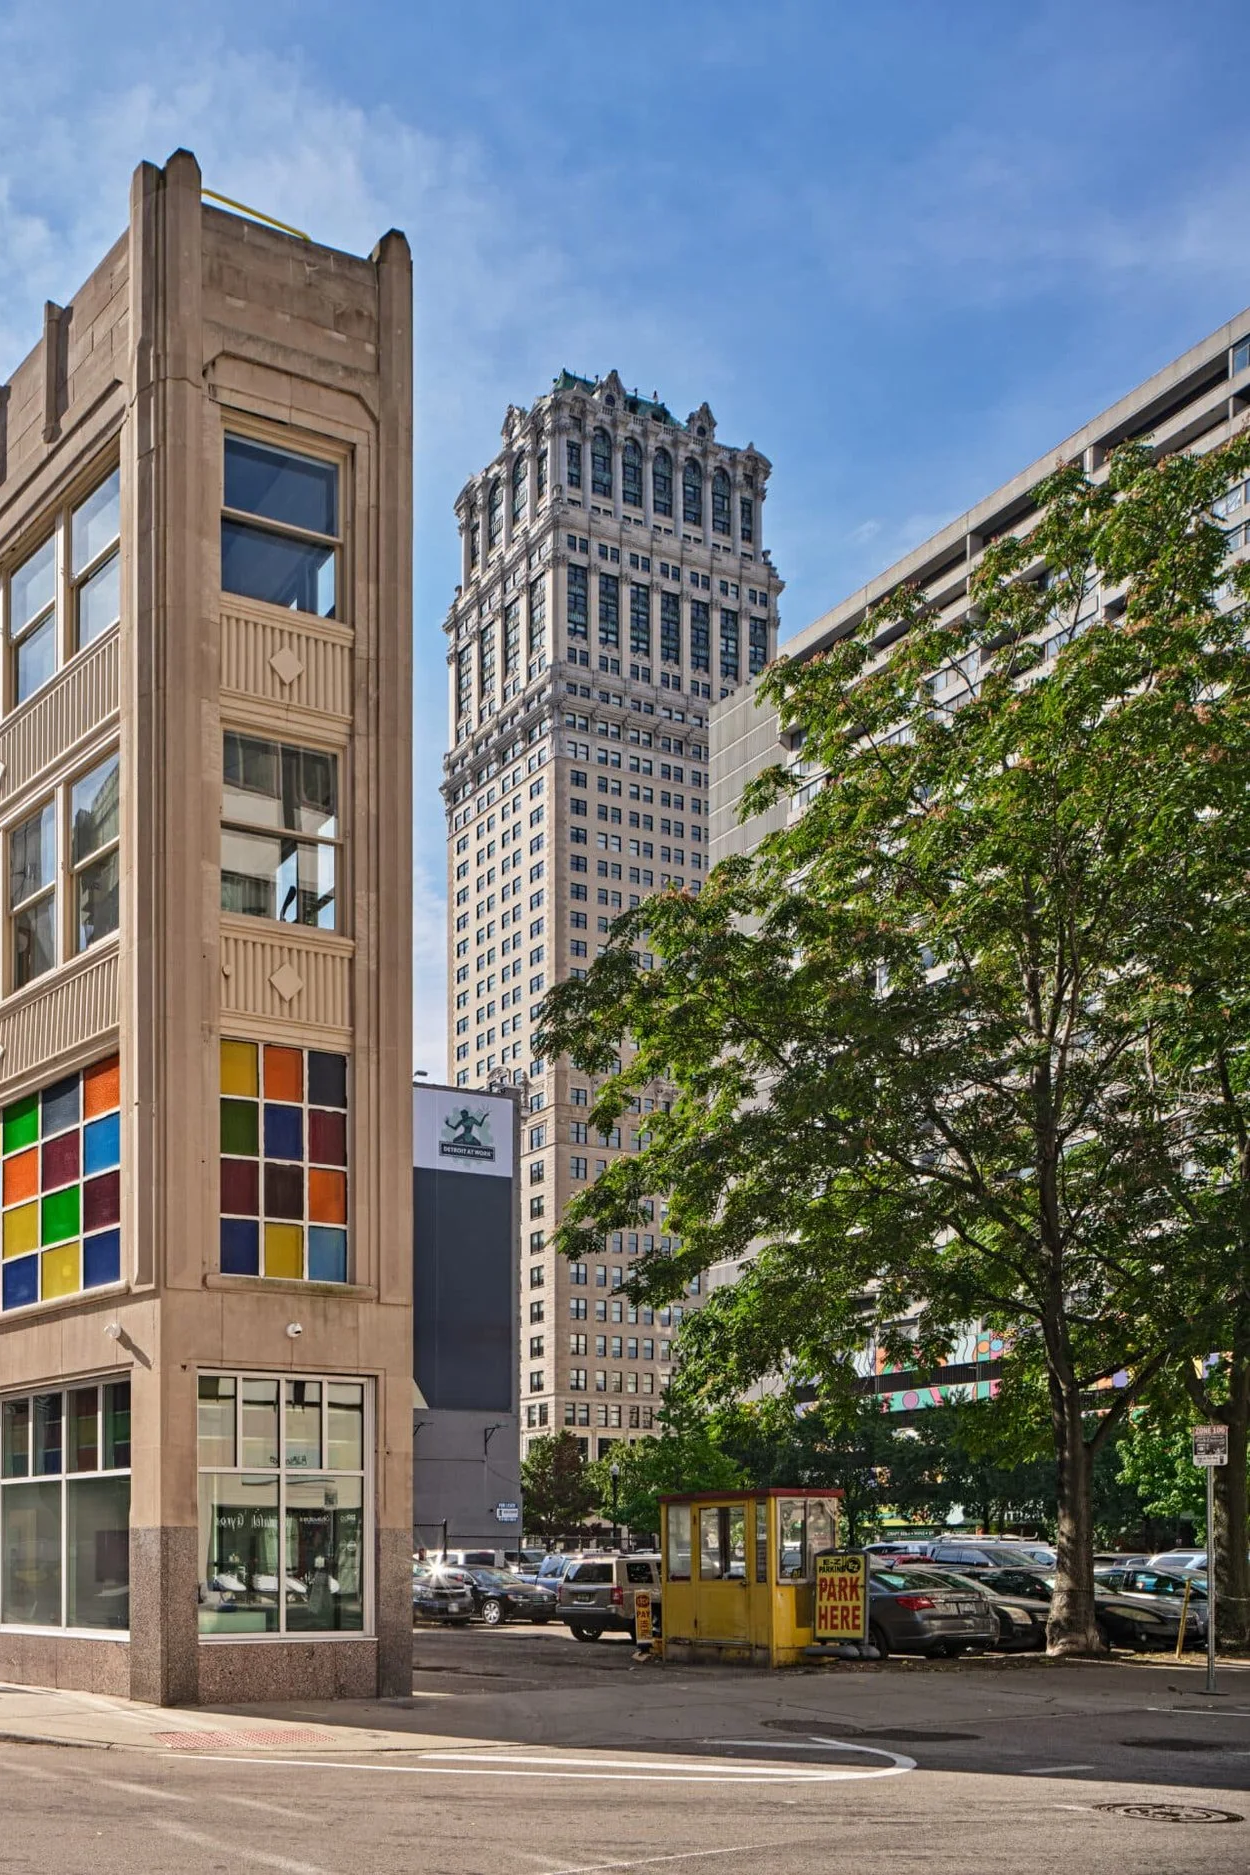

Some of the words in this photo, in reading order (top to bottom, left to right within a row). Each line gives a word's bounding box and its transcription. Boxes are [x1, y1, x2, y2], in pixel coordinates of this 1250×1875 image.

[443, 1145, 467, 1155] DETROIT
[1195, 1425, 1211, 1435] ZONE
[819, 1577, 860, 1602] PARK
[818, 1605, 861, 1631] HERE
